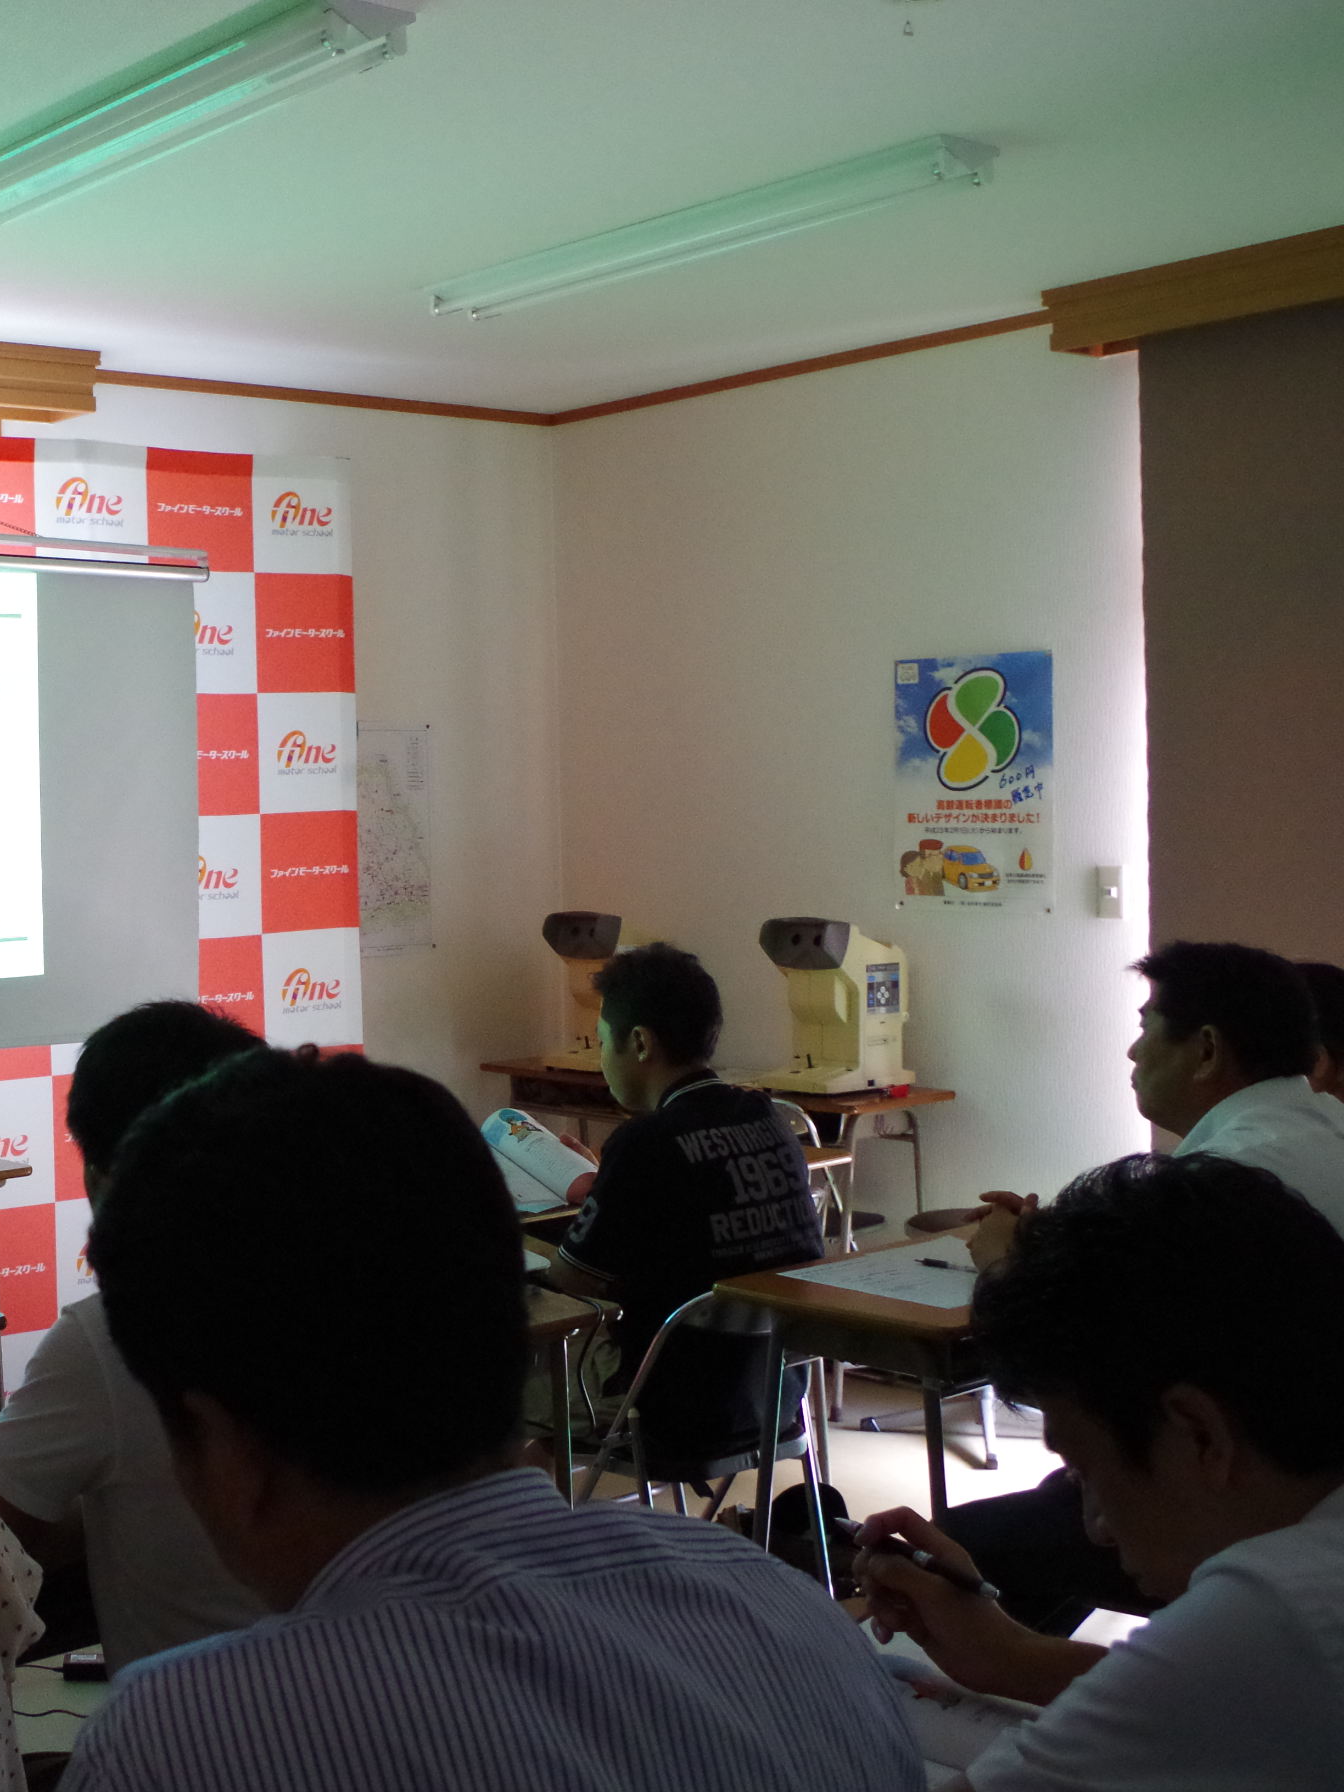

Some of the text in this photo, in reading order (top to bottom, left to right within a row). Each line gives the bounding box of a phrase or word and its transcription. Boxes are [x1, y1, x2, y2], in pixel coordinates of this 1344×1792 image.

[156, 502, 243, 517] ファインモータースクール
[265, 627, 345, 640] ファインモータースクール
[197, 748, 249, 761] モータースクール
[270, 864, 349, 878] ファインモータースクール
